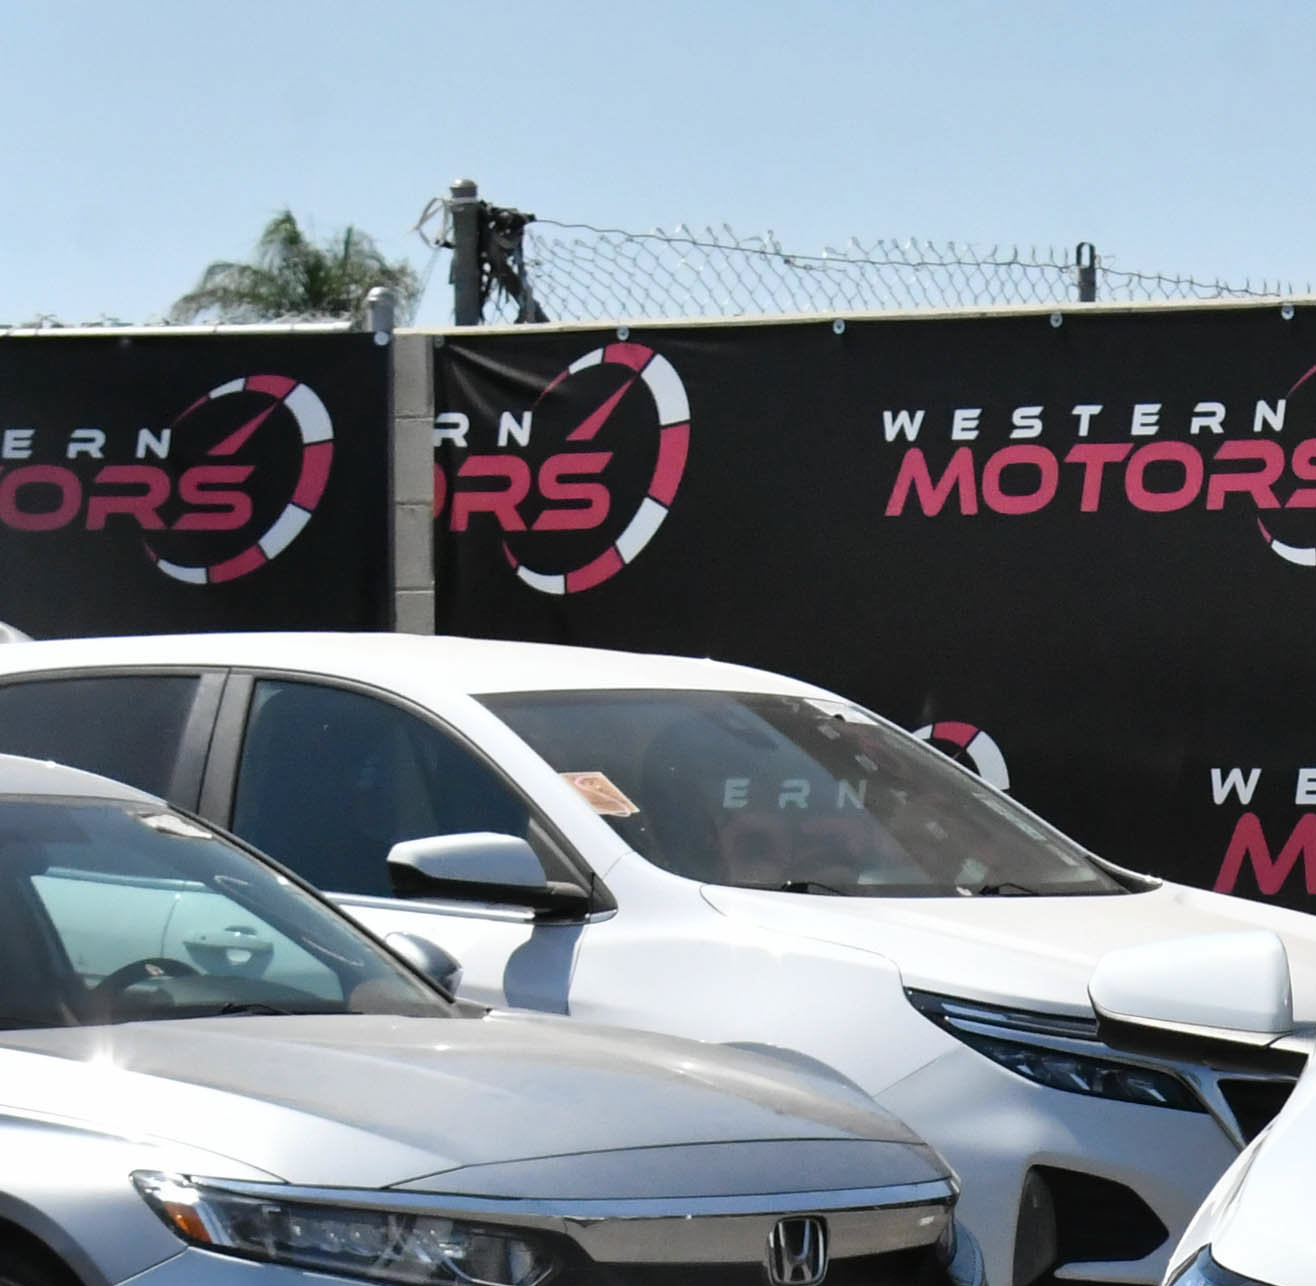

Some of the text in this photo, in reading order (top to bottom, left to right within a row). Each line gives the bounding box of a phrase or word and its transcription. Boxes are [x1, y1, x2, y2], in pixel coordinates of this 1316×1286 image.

[434, 410, 533, 448] RN
[882, 399, 1287, 443] WESTERN
[2, 428, 172, 459] ERN
[0, 464, 256, 531] ORS
[434, 452, 614, 532] RS
